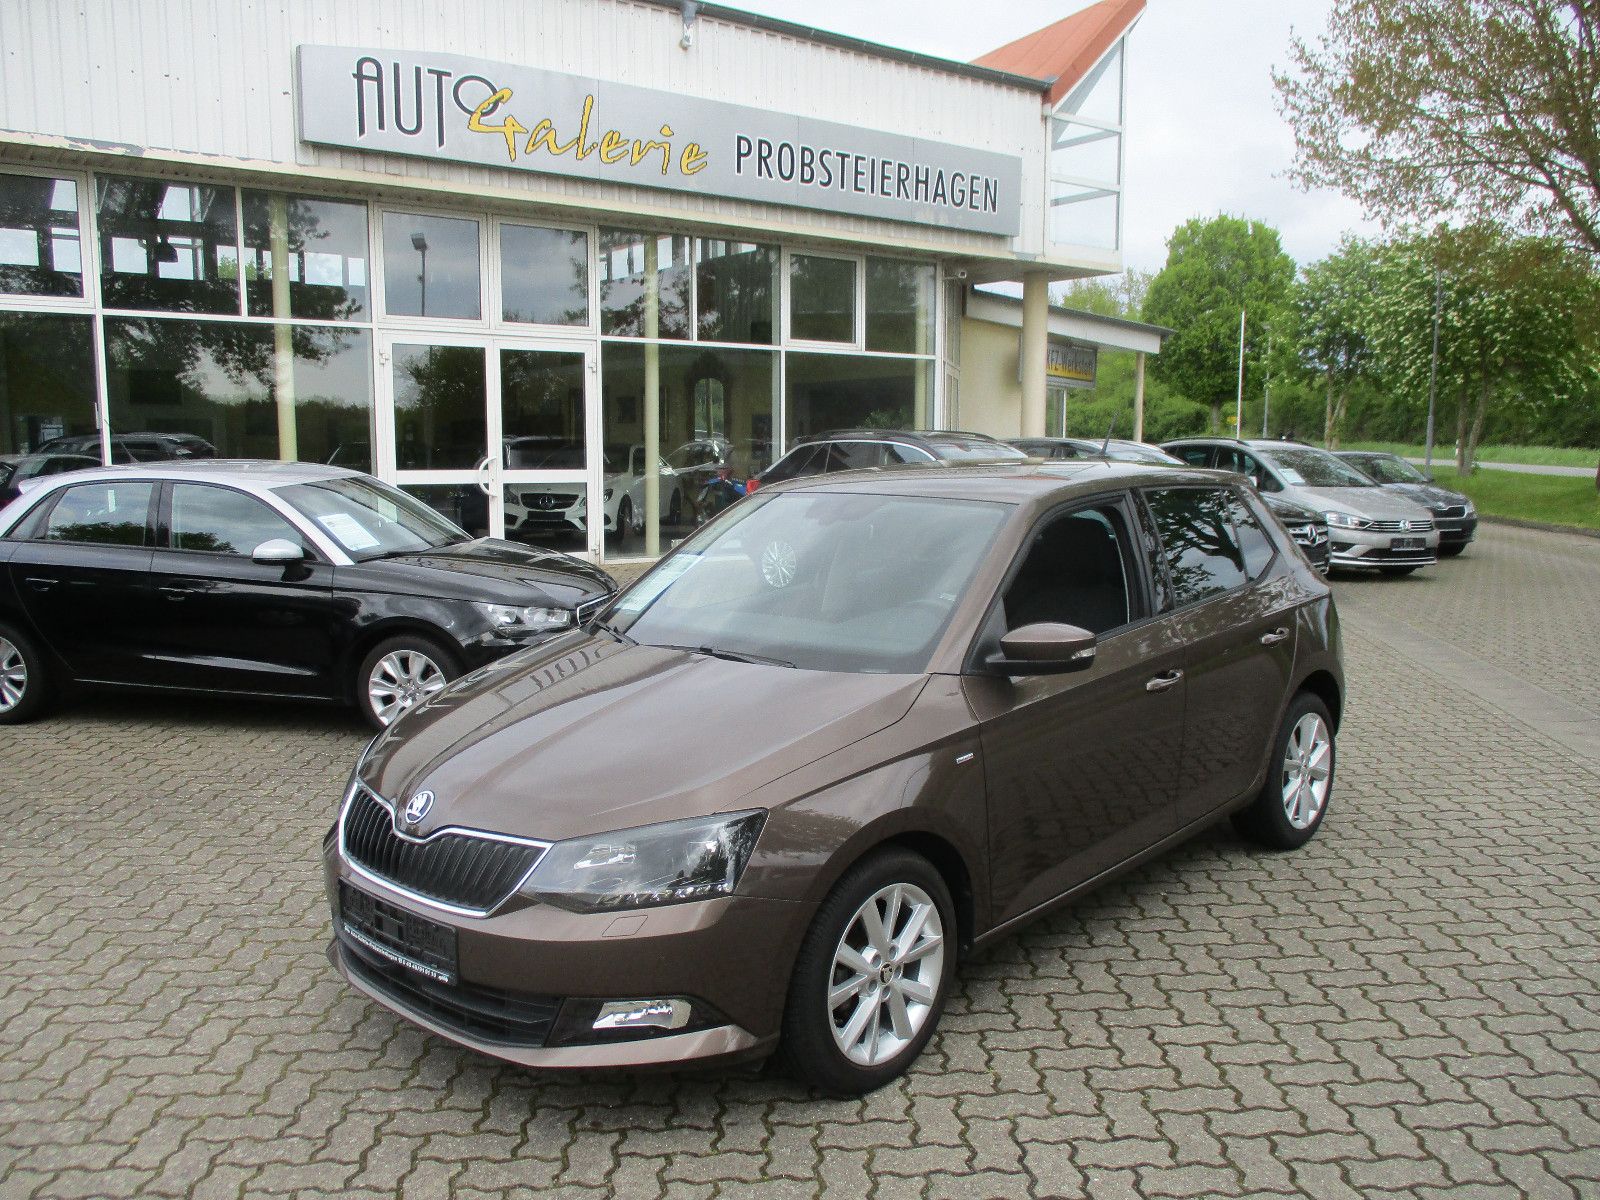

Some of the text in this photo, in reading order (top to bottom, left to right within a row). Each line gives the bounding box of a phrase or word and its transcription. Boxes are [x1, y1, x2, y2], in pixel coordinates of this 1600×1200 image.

[352, 56, 999, 213] AUTO Galerie PROBSTEIERHAGEN
